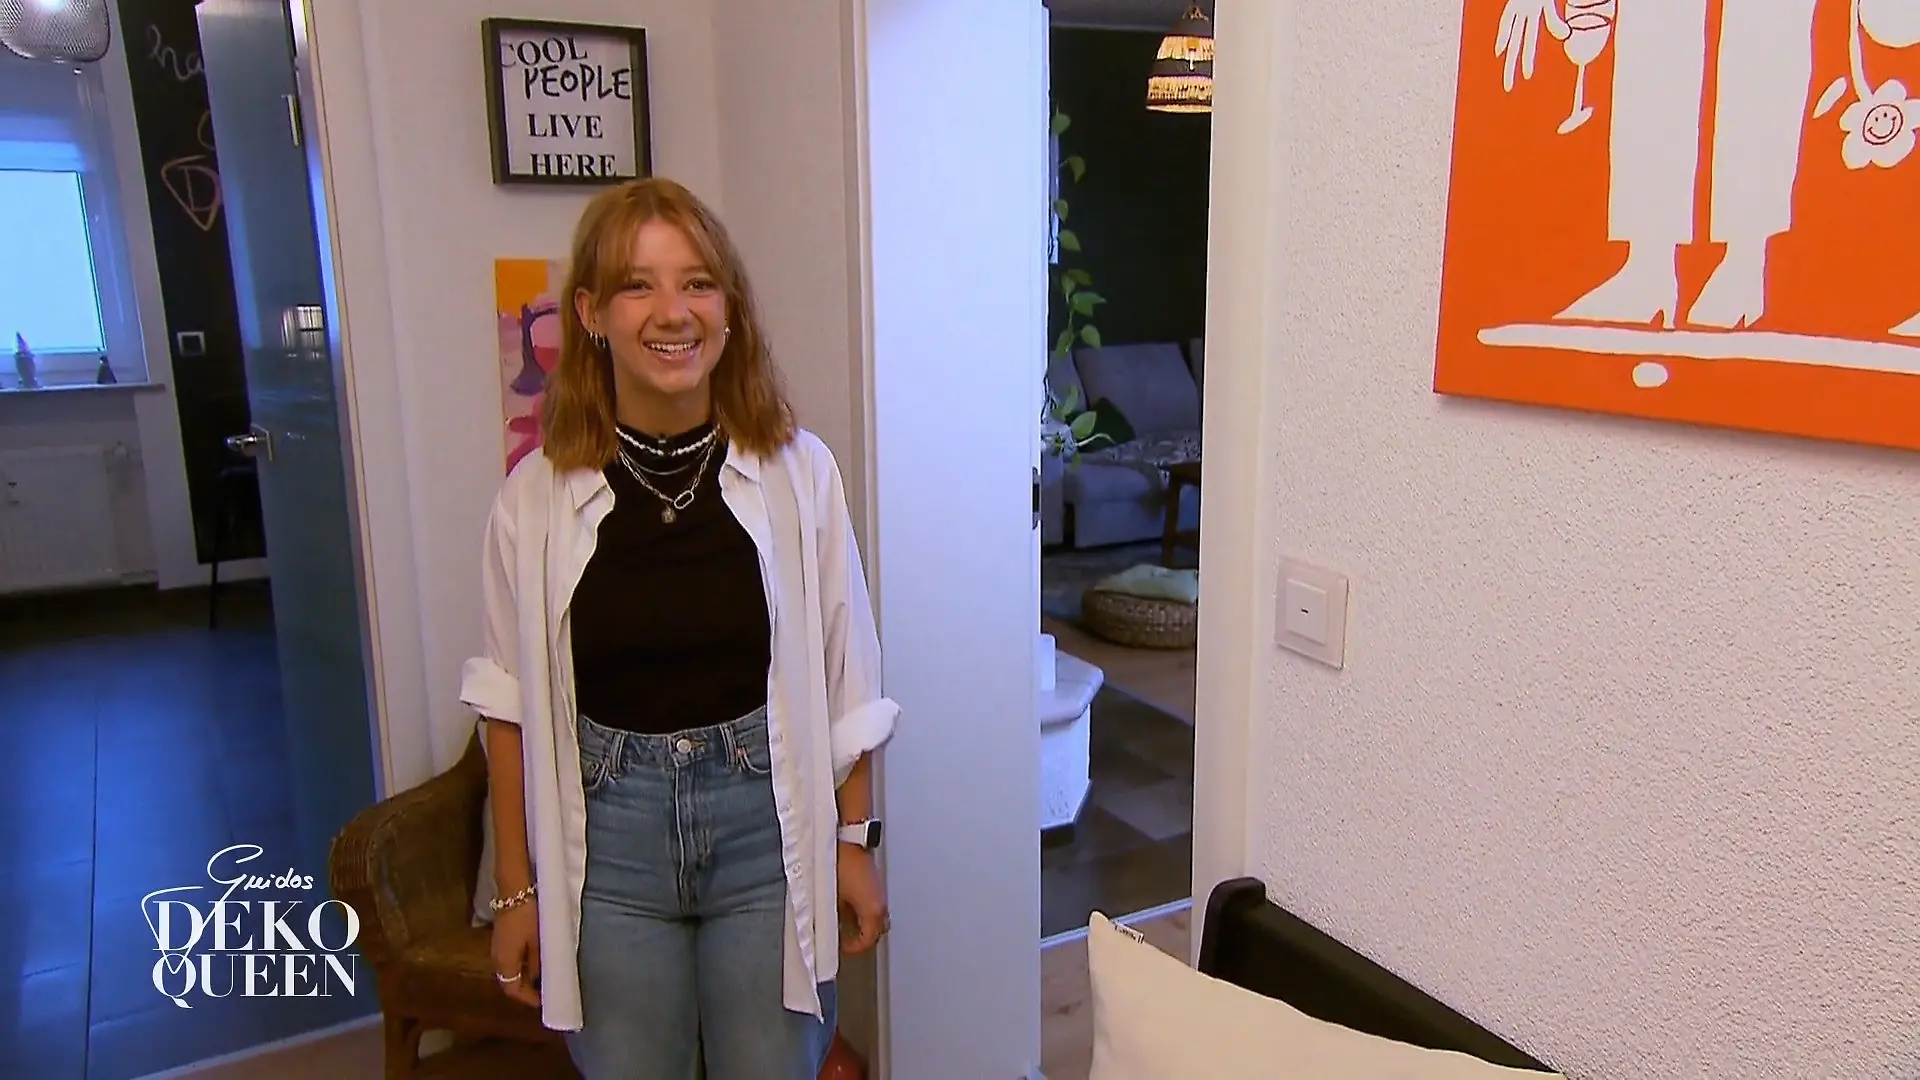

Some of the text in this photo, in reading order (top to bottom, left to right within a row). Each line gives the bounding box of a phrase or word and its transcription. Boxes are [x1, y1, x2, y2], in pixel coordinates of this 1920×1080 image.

[500, 36, 588, 68] COOL
[524, 63, 631, 101] PEOPLE
[528, 113, 603, 139] LIVE
[530, 153, 617, 176] HERE
